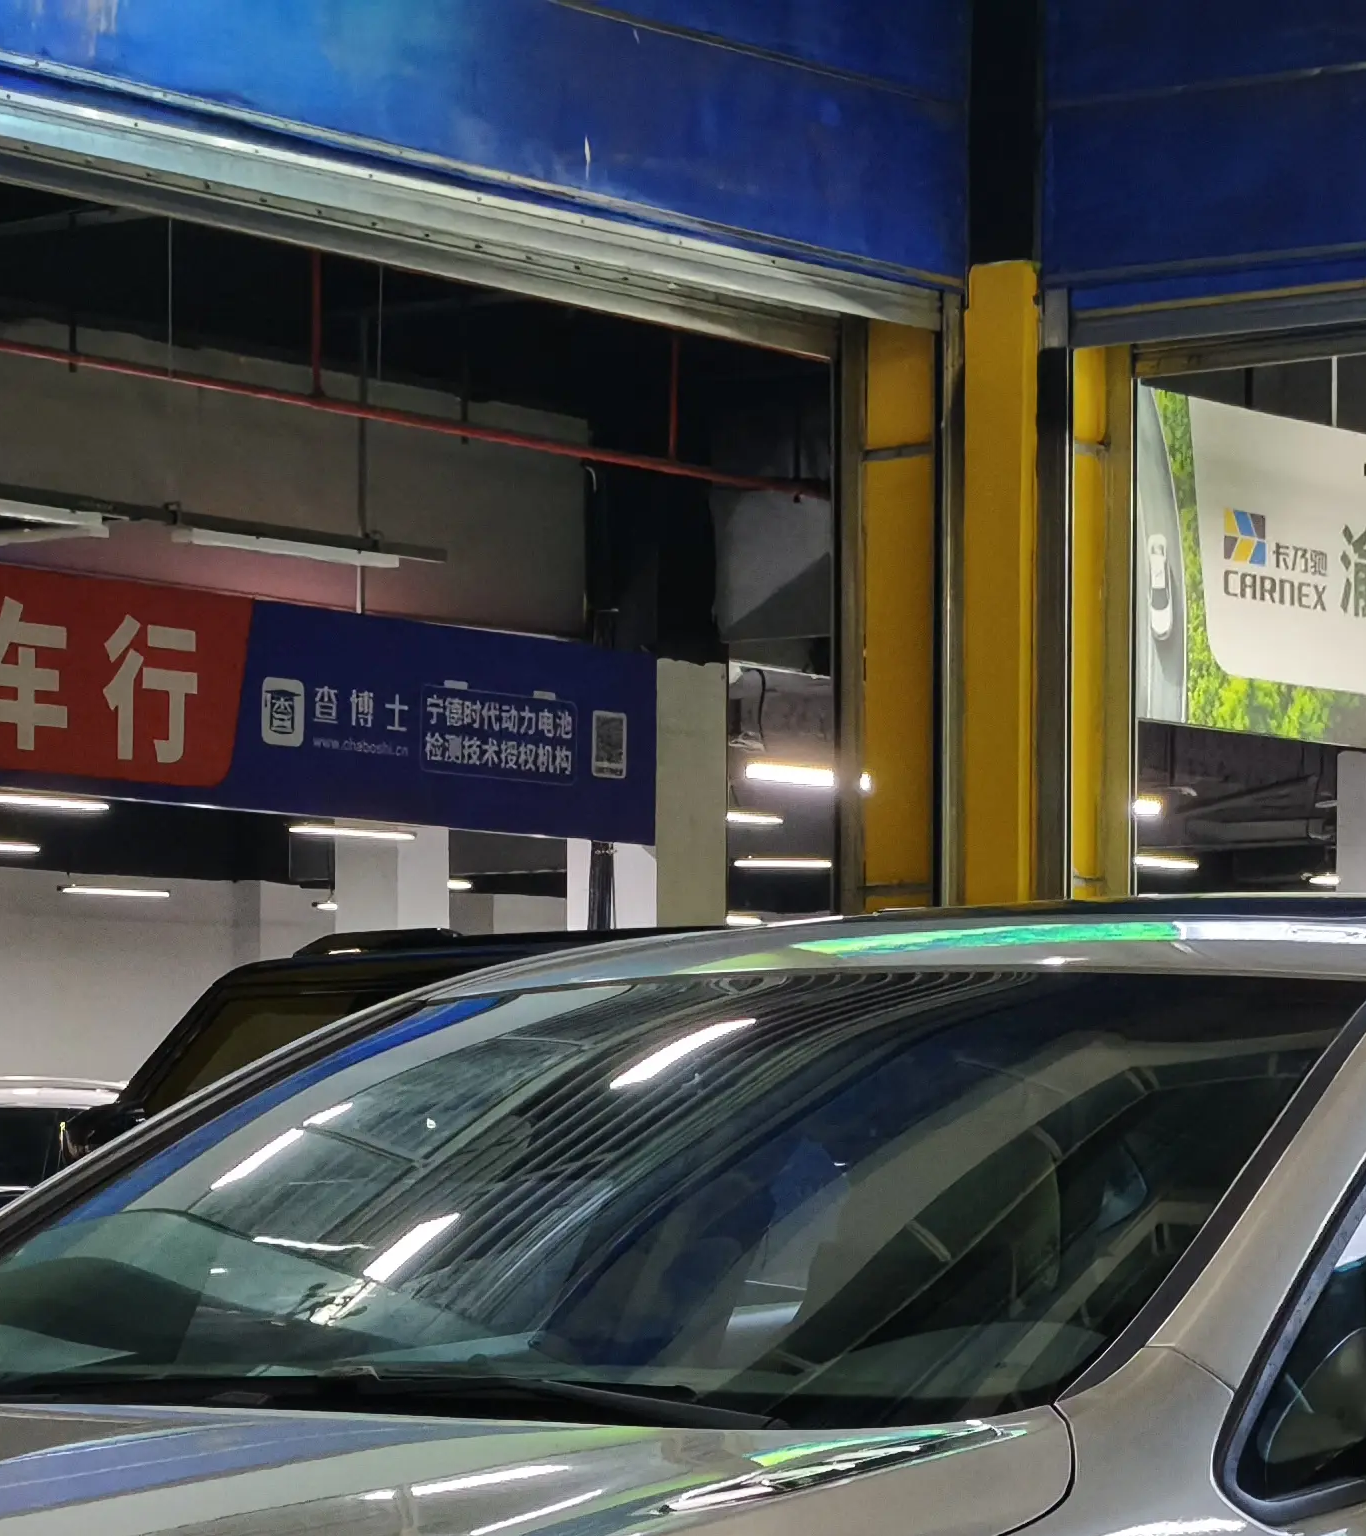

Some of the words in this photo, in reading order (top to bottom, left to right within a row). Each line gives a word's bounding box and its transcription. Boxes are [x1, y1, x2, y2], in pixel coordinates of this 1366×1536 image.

[1223, 569, 1328, 612] CARNEX
[312, 685, 410, 732] 查博士
[426, 694, 573, 740] 宁德时代动力电池
[425, 731, 573, 776] 检测技术授权机构
